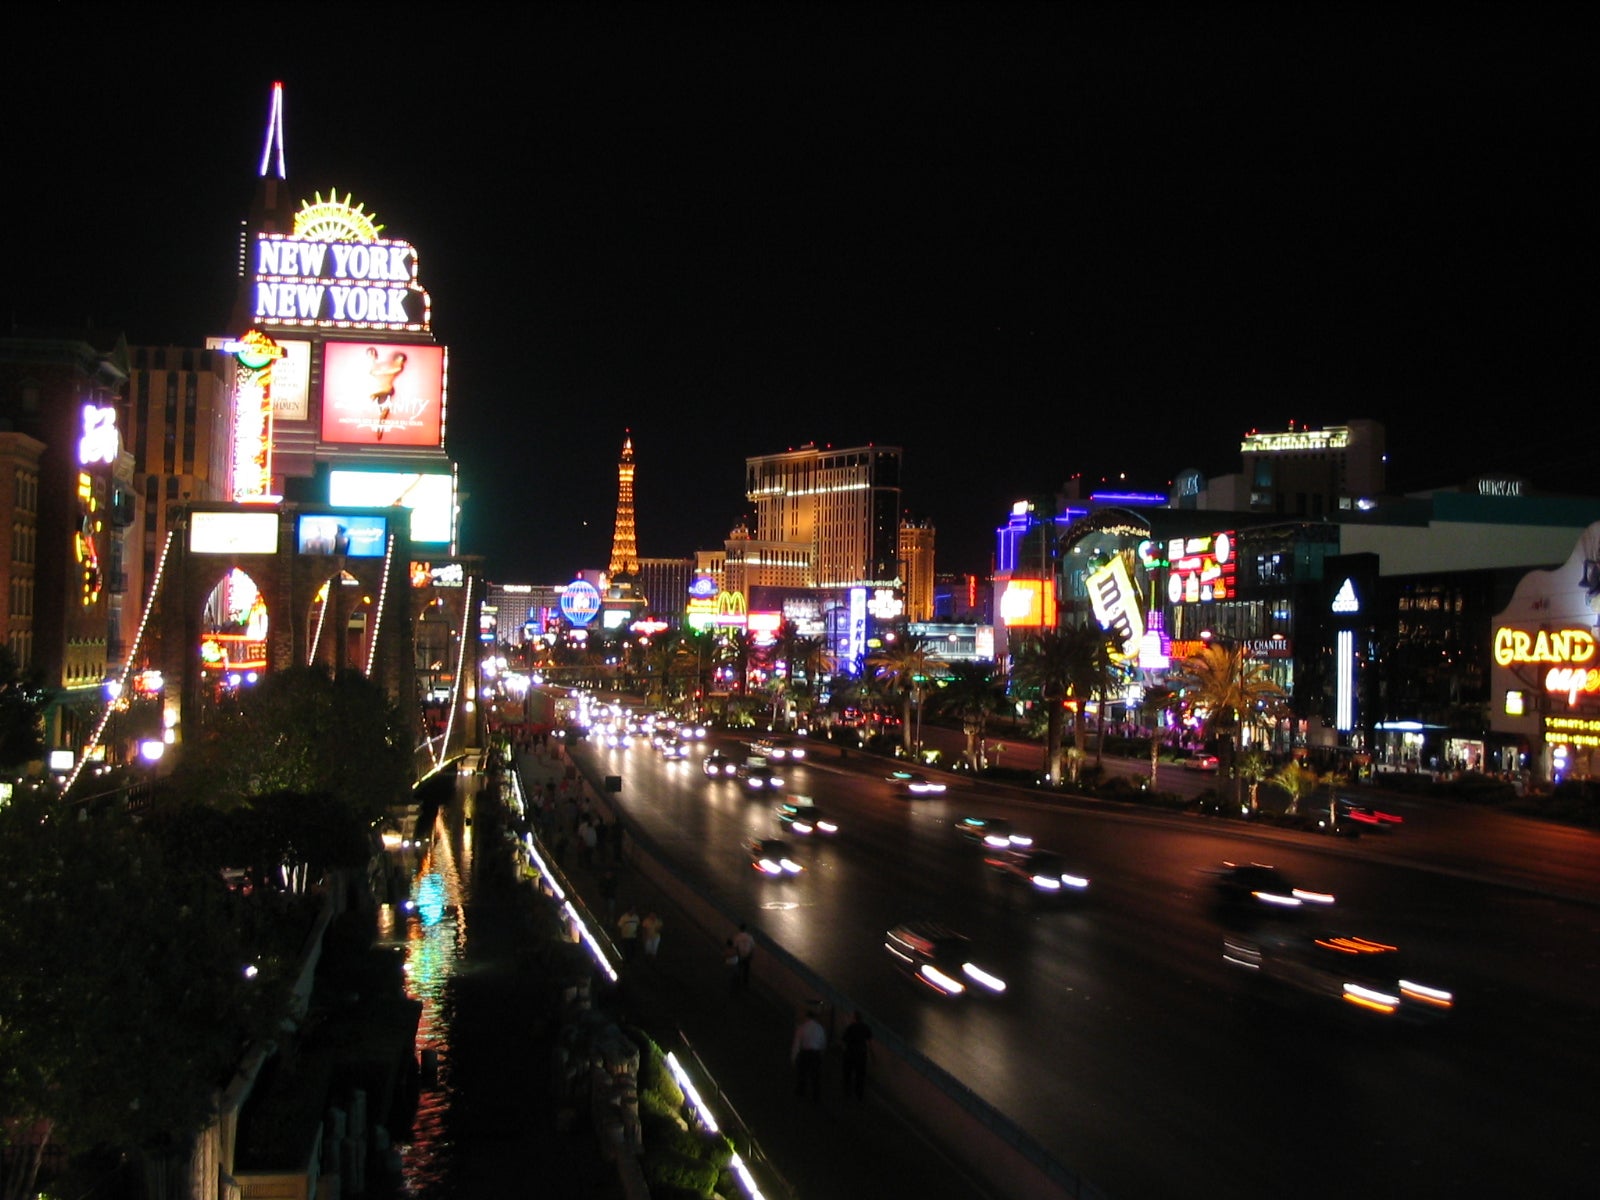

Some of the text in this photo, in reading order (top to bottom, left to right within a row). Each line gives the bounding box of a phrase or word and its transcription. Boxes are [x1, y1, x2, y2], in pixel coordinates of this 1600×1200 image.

[259, 241, 410, 281] NEW YORK
[256, 282, 409, 322] NEW YORK
[1254, 640, 1287, 651] CHANTRE
[1494, 627, 1595, 666] GRAND
[1545, 717, 1584, 730] T-SHIRTS
